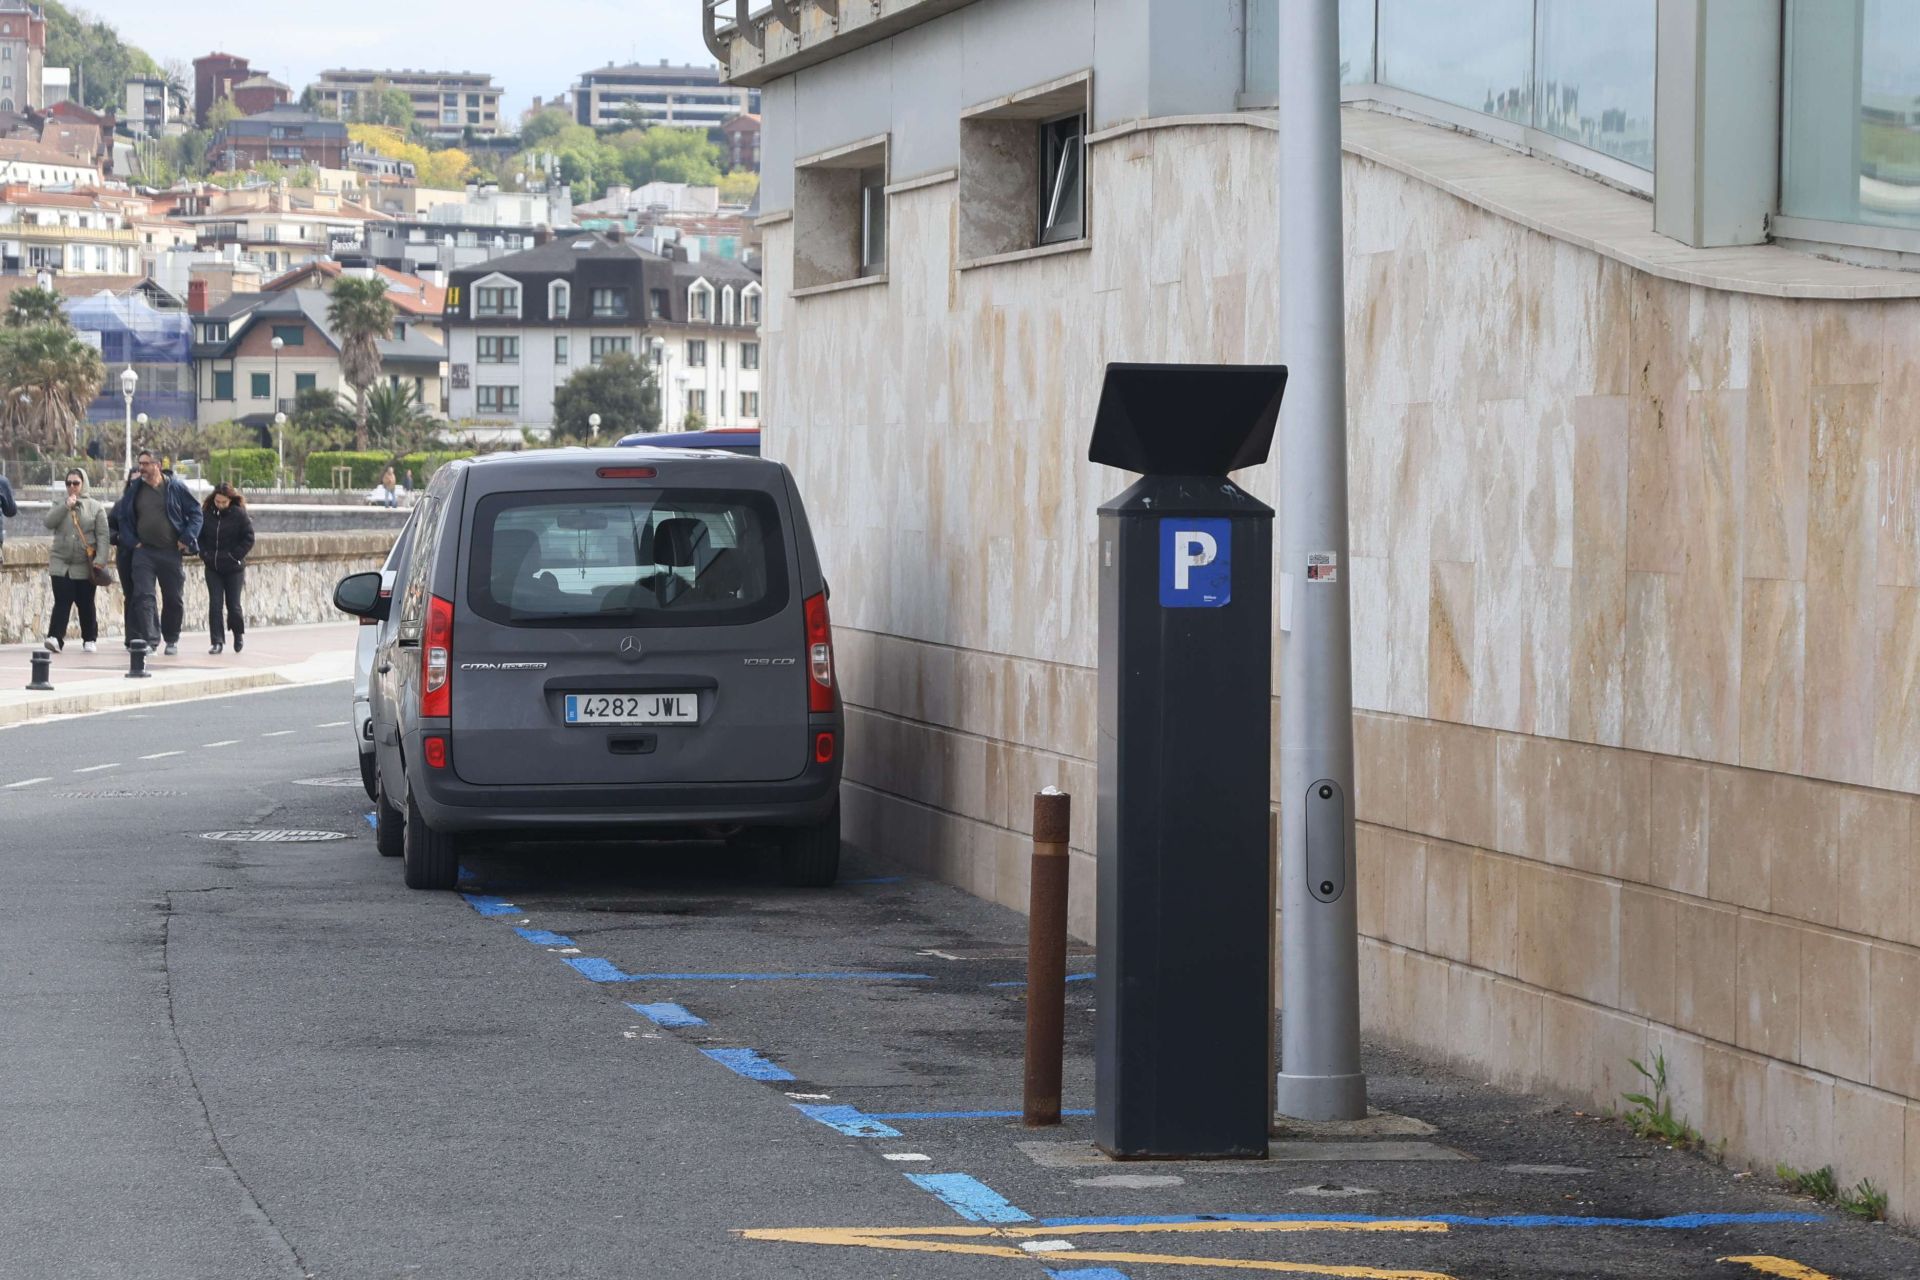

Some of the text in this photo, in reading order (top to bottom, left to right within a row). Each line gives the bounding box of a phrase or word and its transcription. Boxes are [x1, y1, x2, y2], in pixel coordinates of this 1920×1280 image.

[1174, 531, 1218, 590] P
[501, 662, 548, 670] TOURER
[583, 697, 689, 718] 4282 JWL
